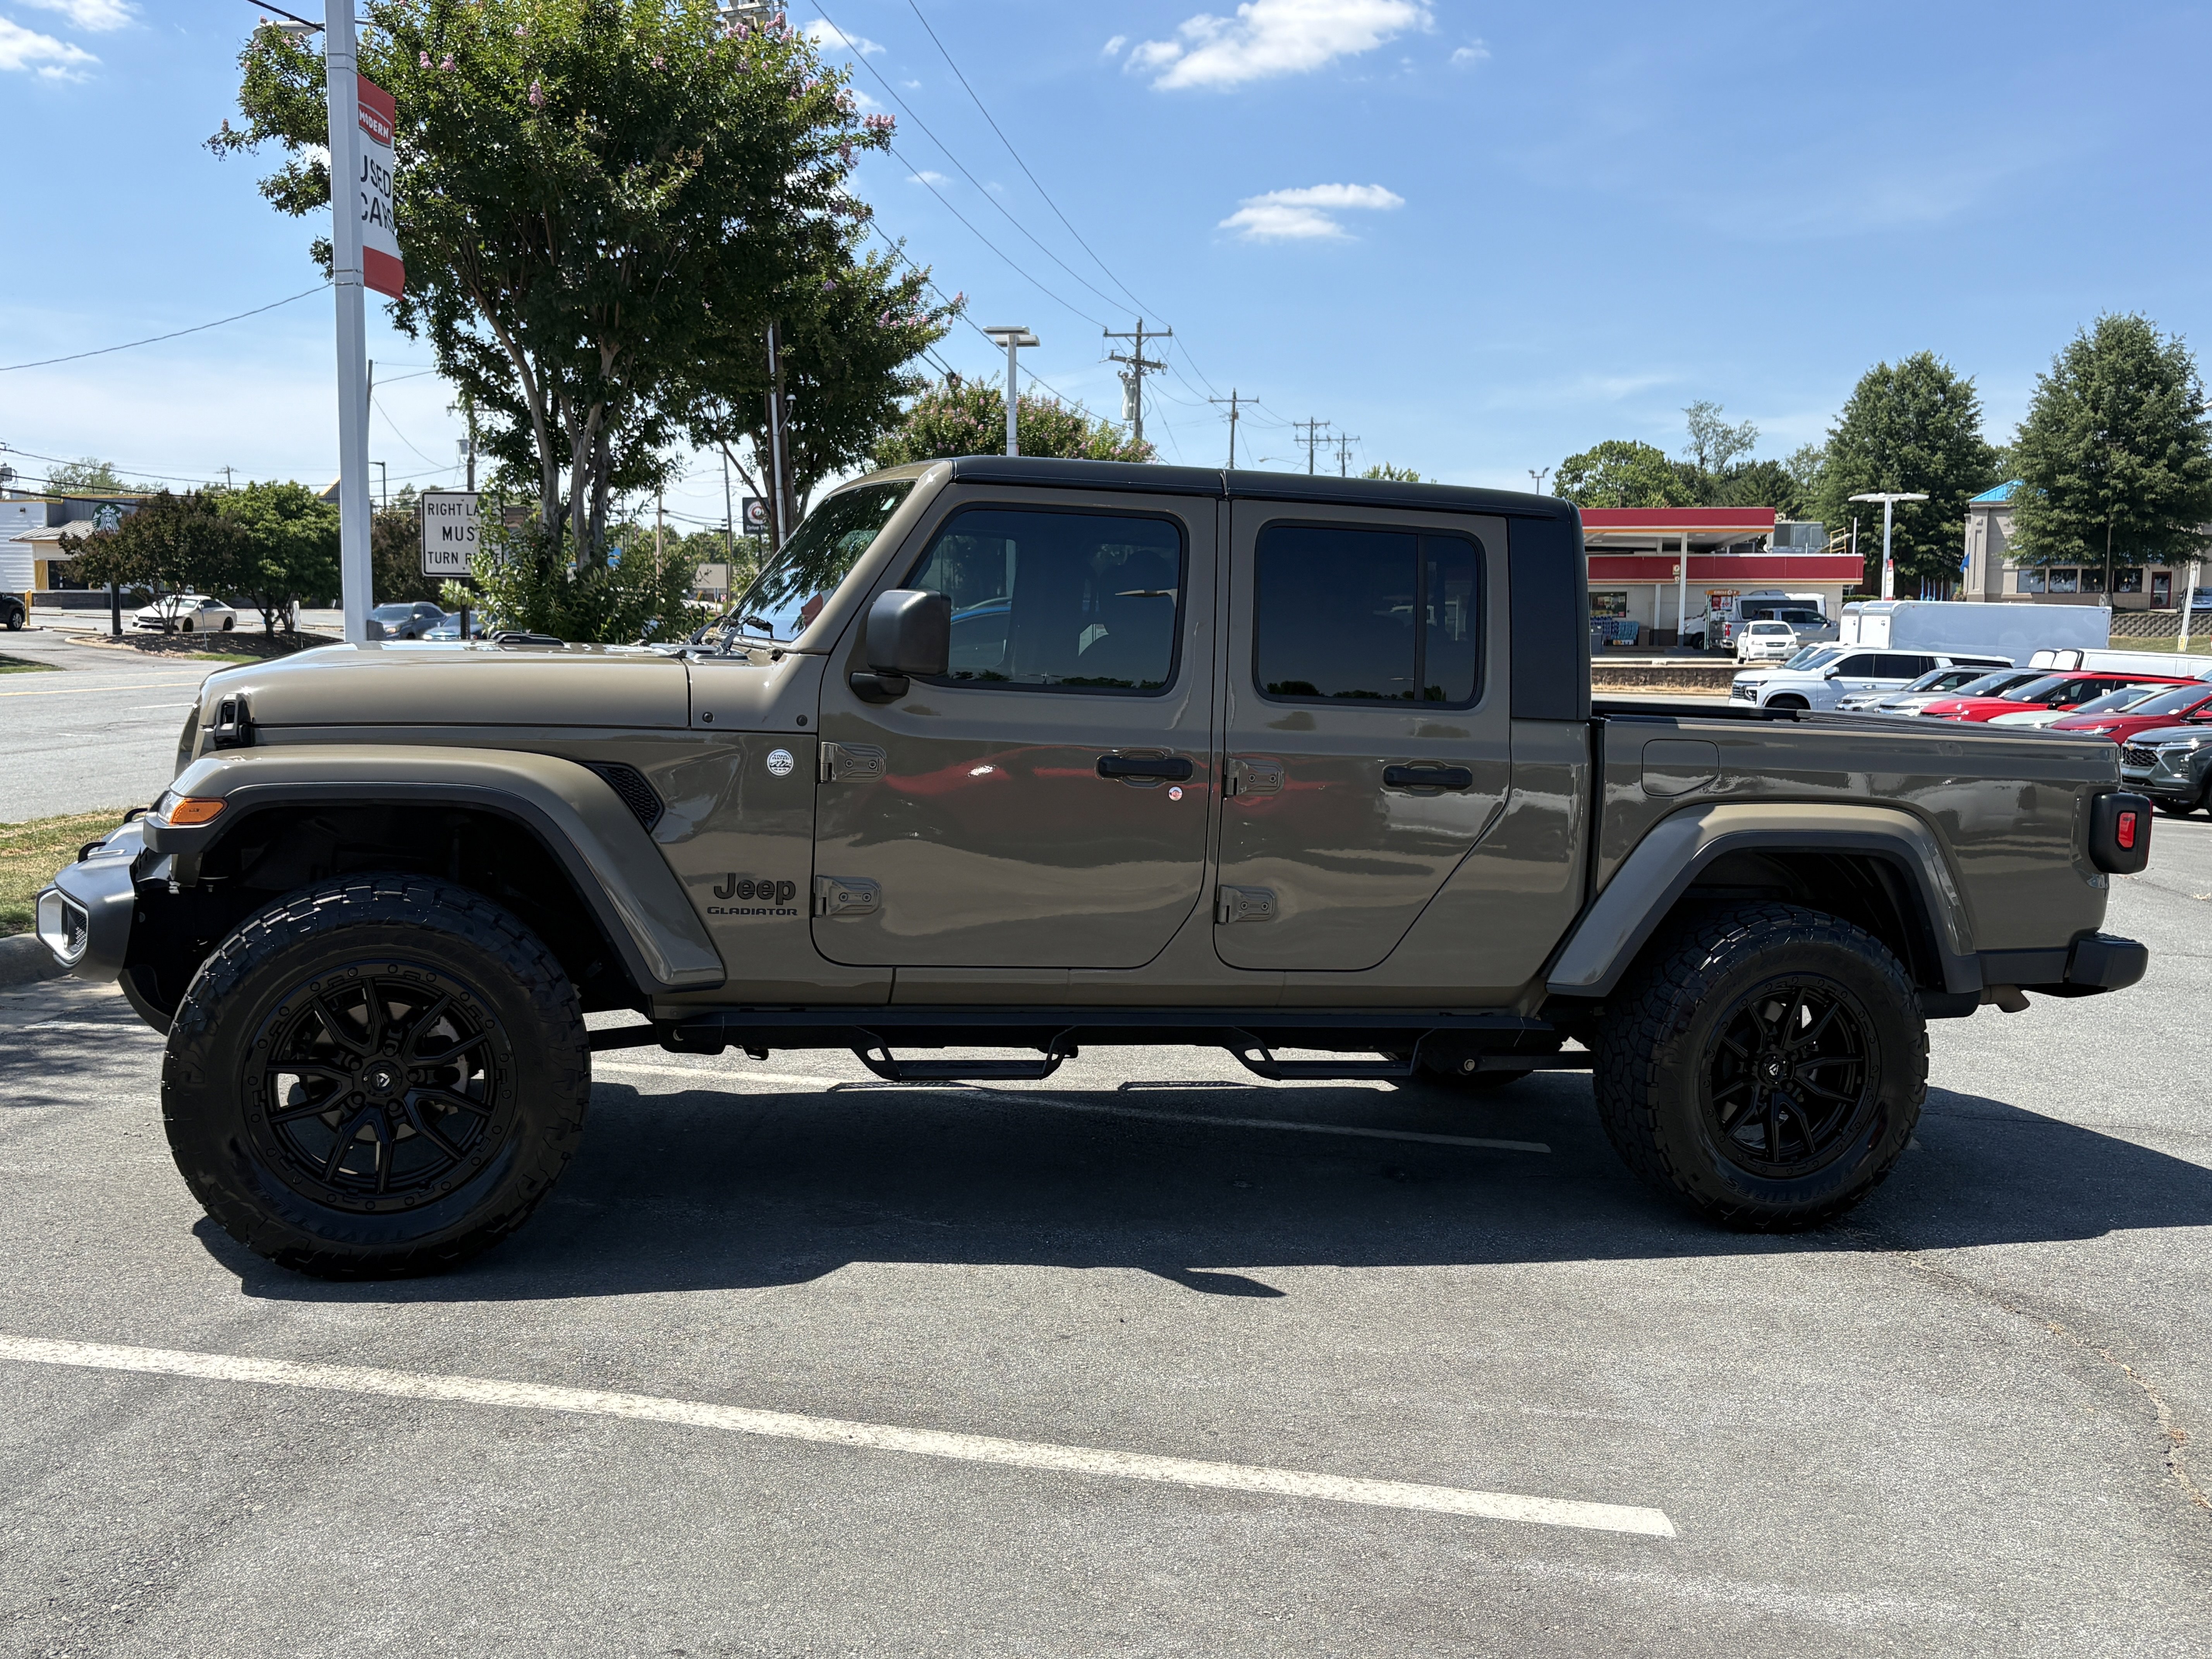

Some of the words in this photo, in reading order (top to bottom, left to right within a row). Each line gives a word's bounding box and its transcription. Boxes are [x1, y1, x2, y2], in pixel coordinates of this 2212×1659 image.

[359, 109, 389, 139] MODERN
[360, 155, 391, 199] USED
[428, 503, 463, 516] RIGHT
[428, 551, 459, 564] TURN
[714, 873, 796, 905] Jeep
[707, 907, 798, 915] GLADIATOR
